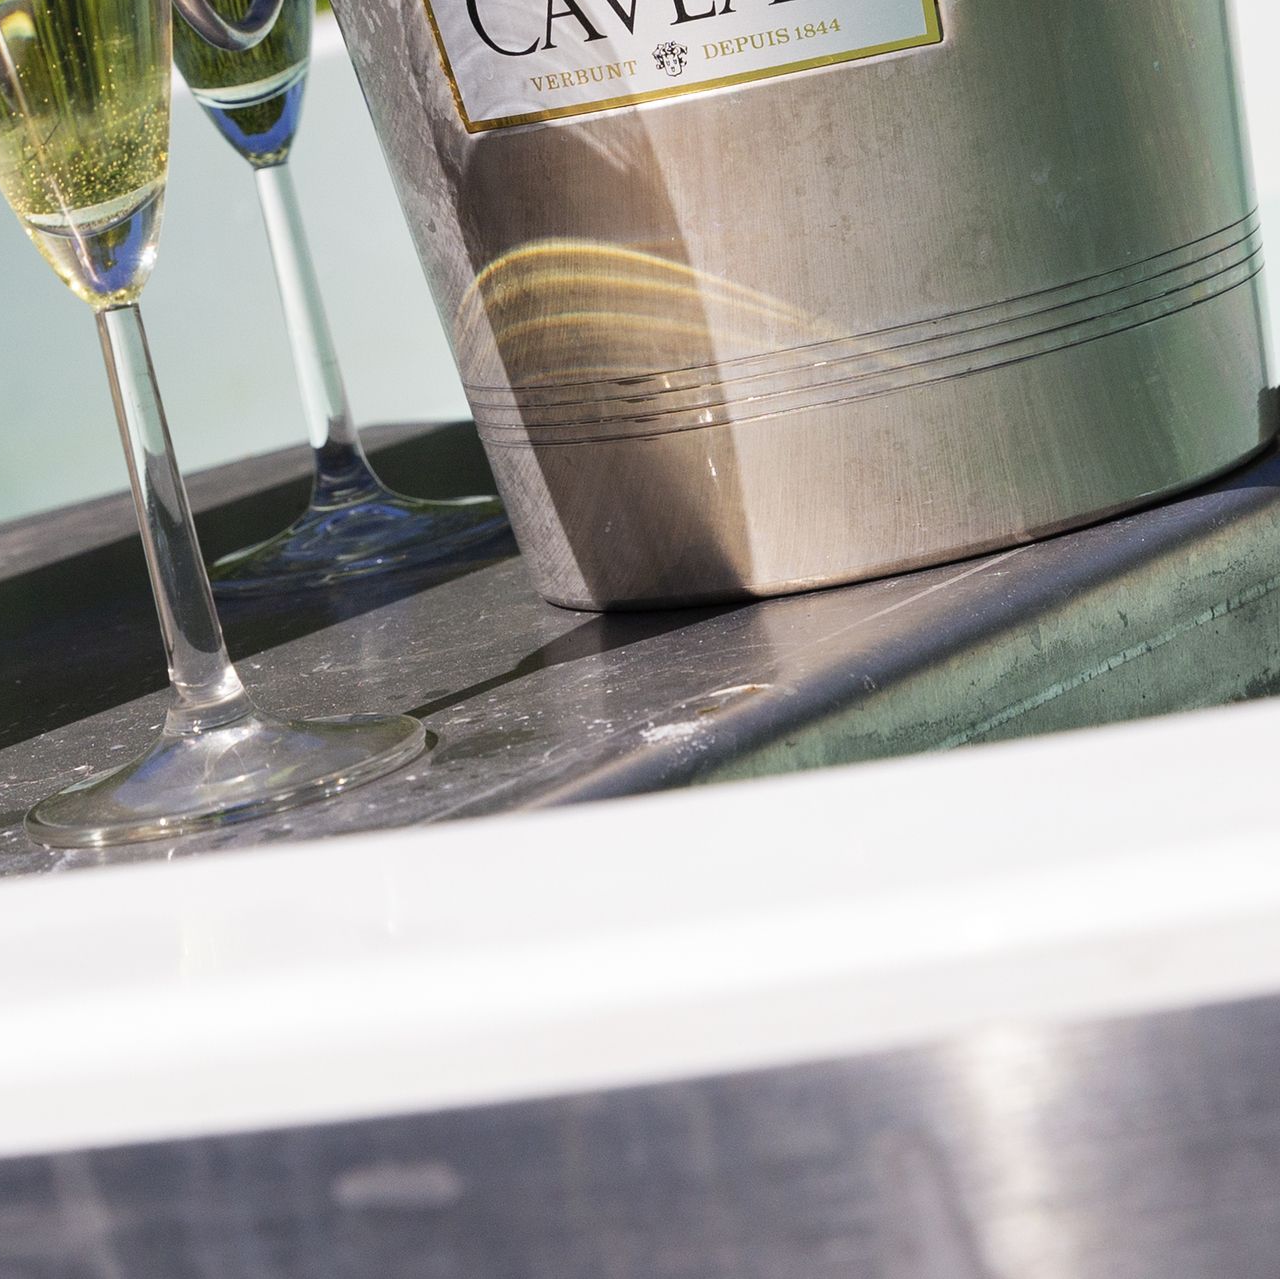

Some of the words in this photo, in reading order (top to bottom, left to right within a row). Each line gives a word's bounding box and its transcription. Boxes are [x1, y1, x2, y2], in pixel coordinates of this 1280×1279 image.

[530, 60, 637, 92] VERBUNT
[702, 26, 790, 60] DEPUIS
[794, 18, 841, 41] 1844
